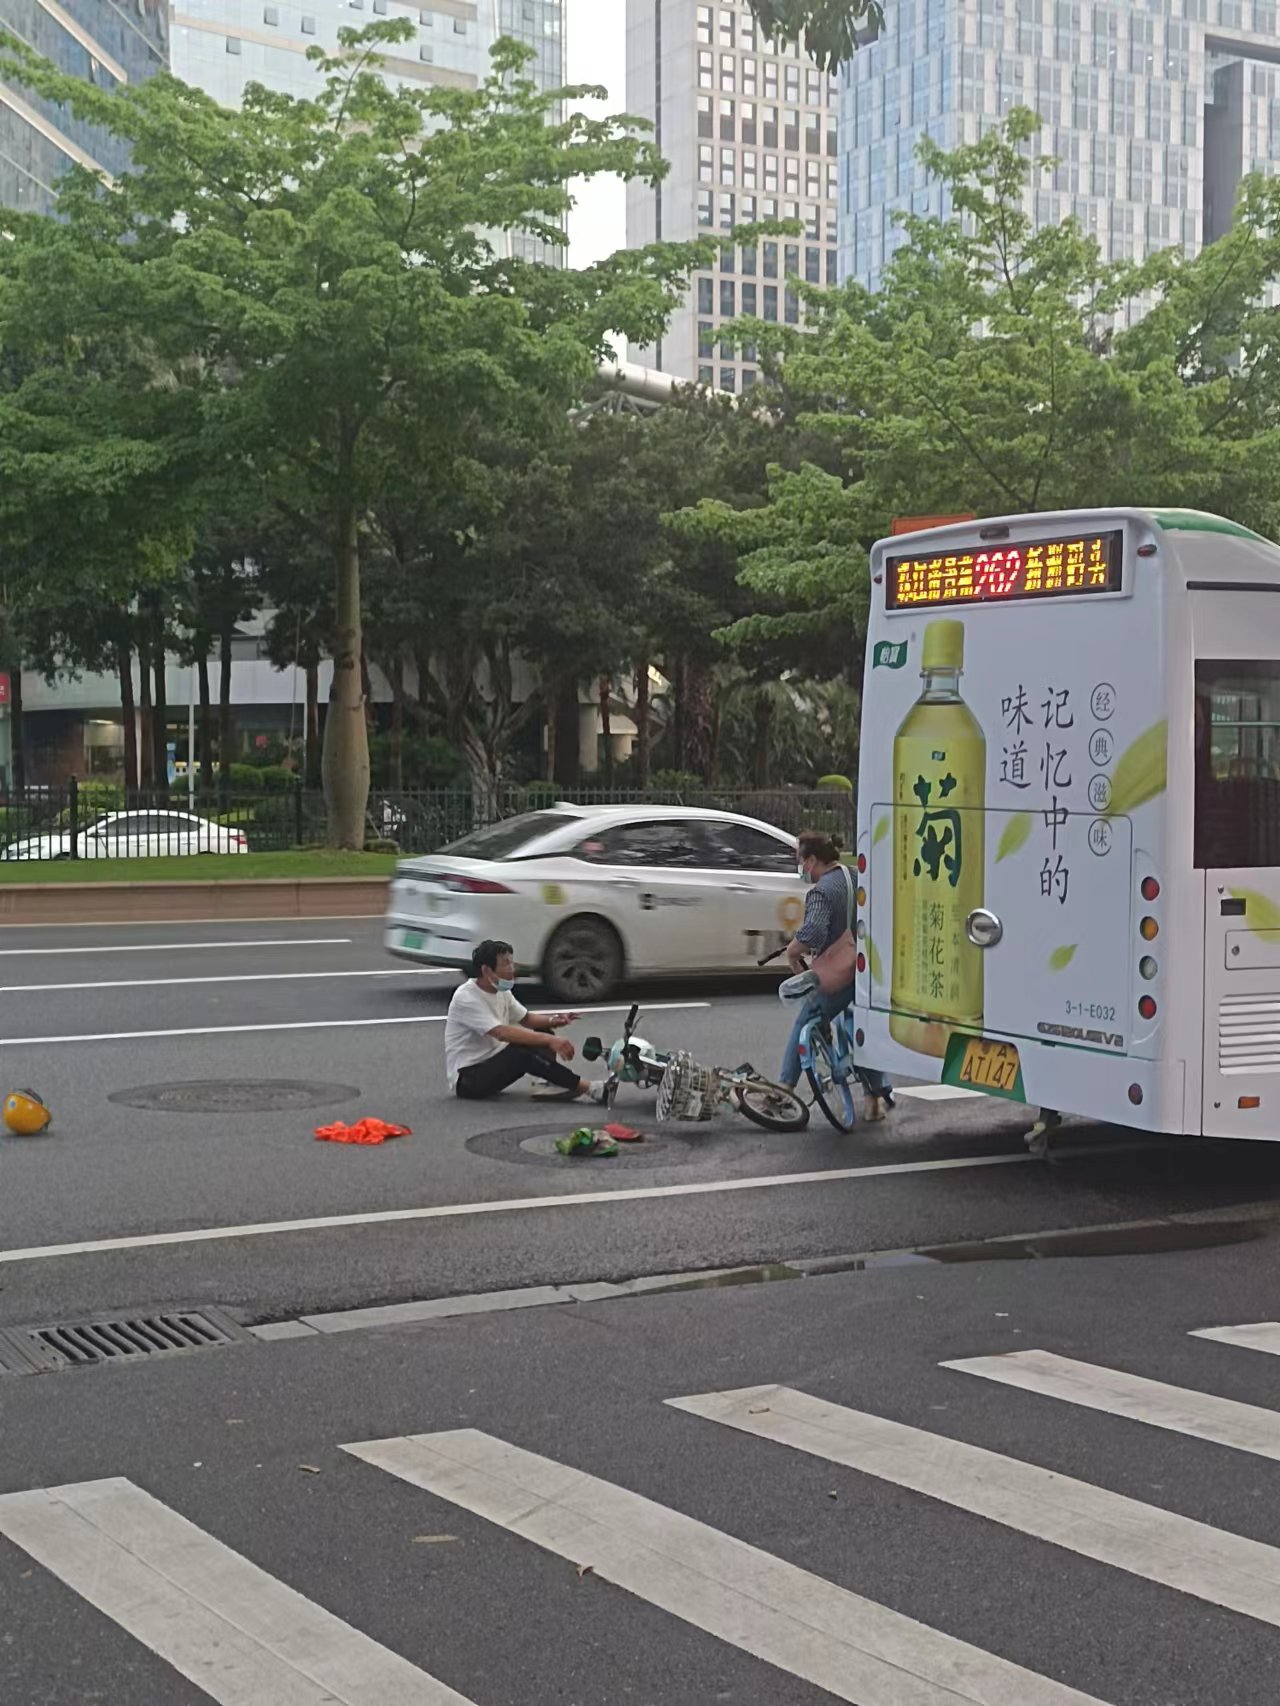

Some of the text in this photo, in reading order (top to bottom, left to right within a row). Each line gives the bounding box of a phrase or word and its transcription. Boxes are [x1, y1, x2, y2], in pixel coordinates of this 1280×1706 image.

[1000, 684, 1034, 790] 味道
[1039, 686, 1074, 905] 记忆中的
[929, 903, 945, 999] 菊花茶
[1065, 999, 1116, 1022] 3-1-E032
[962, 1053, 1016, 1088] AT147
